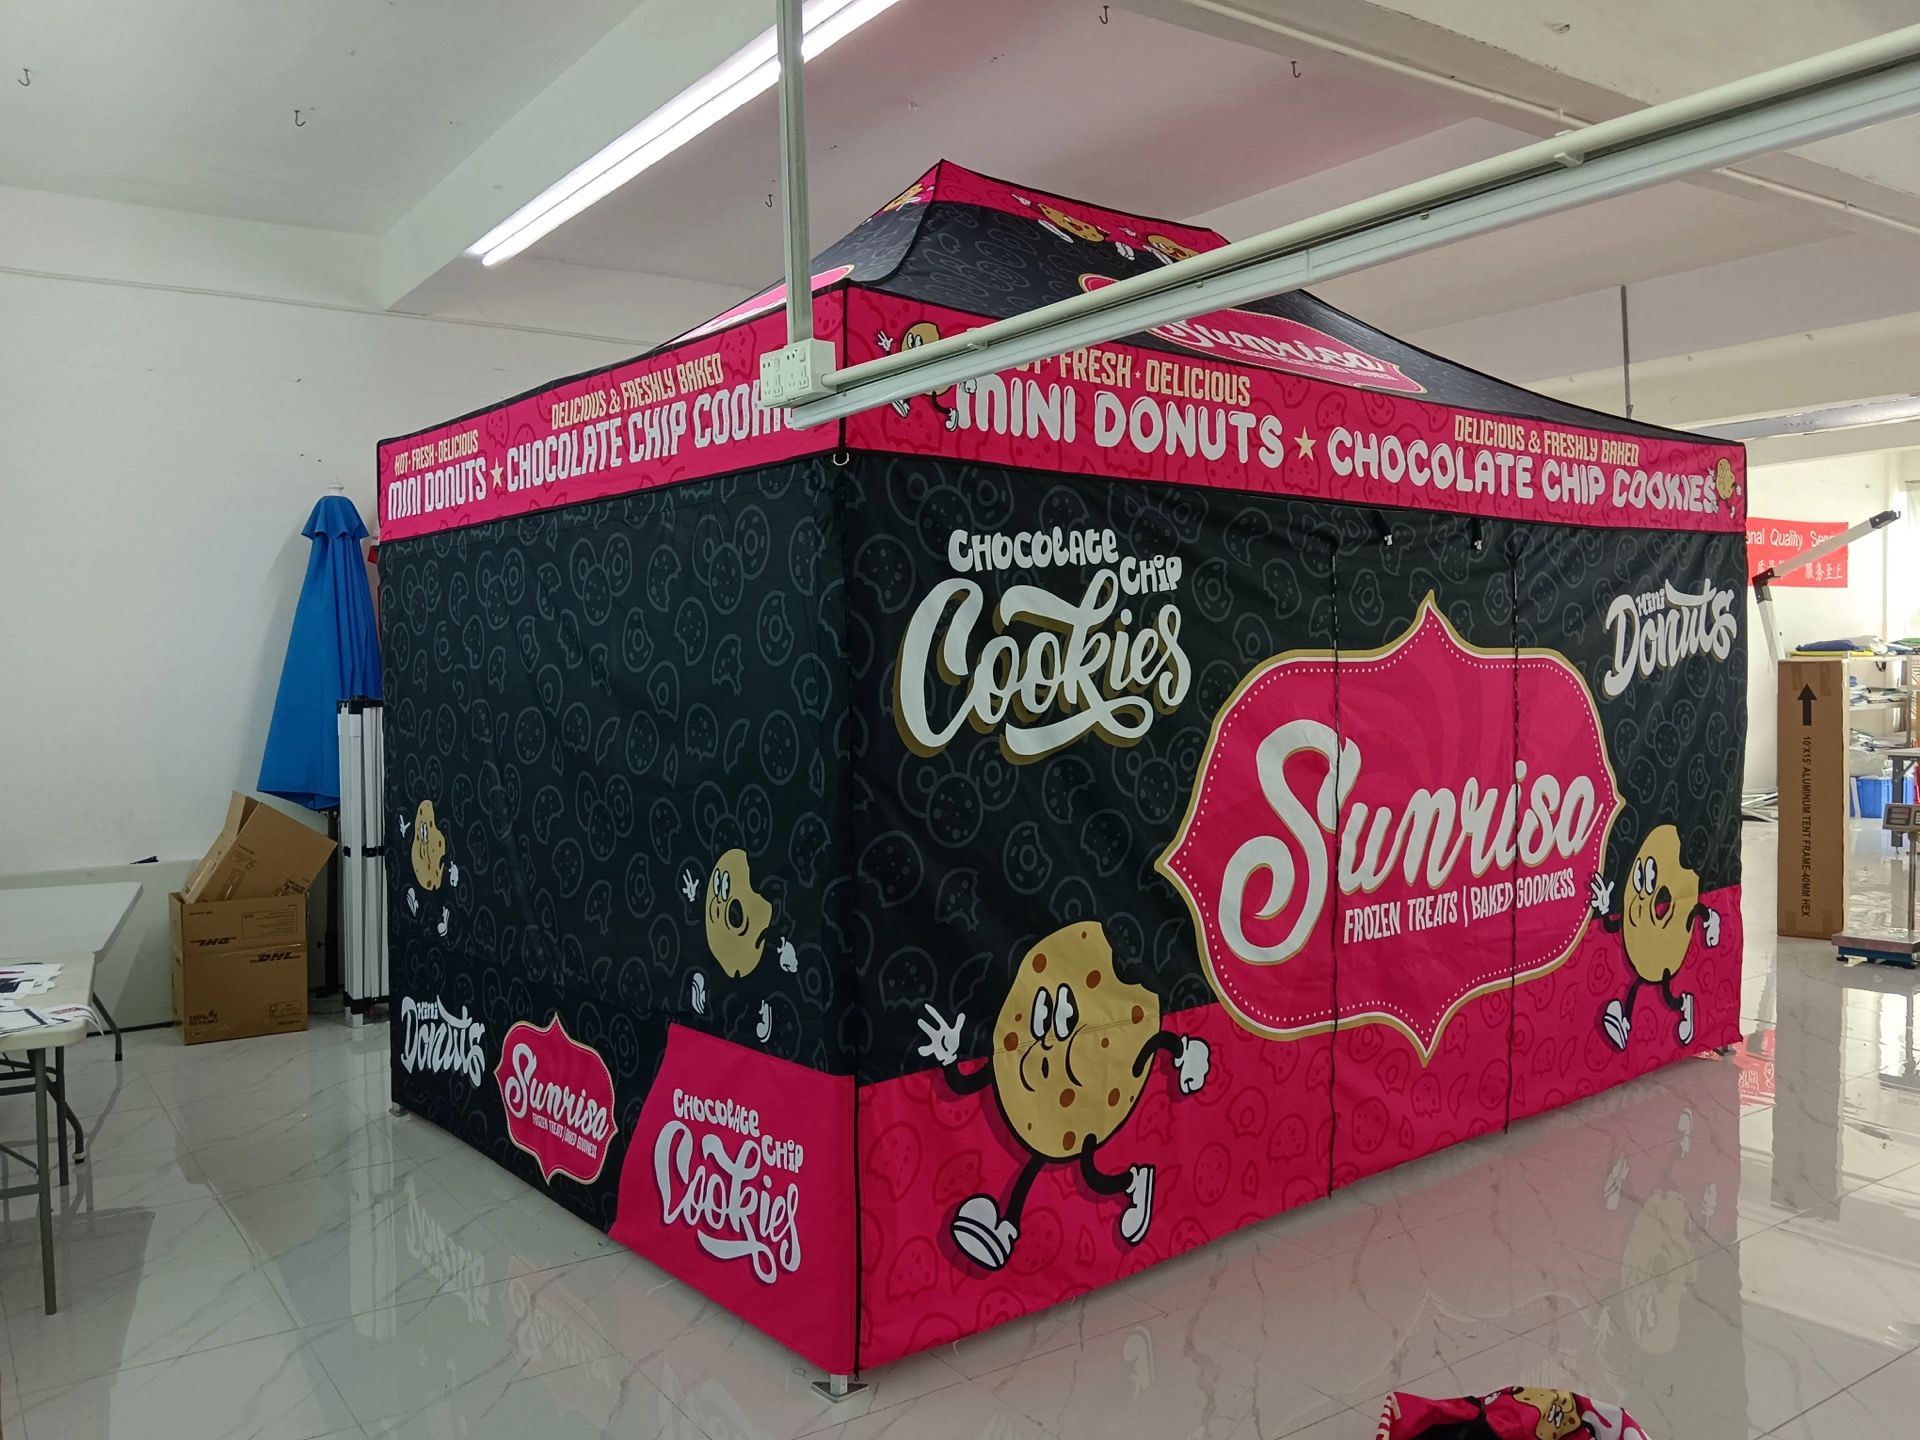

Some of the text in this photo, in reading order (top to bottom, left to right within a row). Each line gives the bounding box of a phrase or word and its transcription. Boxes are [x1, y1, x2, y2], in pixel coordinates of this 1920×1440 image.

[552, 352, 724, 430] DELICIOUS & FRESHLY BAKED
[1059, 347, 1132, 389] FRESH
[1145, 359, 1252, 408] DELICIOUS
[395, 429, 479, 475] HOT FRESH DELICIOUS
[507, 379, 806, 492] CHOCOLATE CHIP COOK
[956, 373, 1285, 469] MINI DONUTS
[1454, 414, 1640, 468] DELICIOUS & FRESHLY BAKED
[388, 457, 487, 520] MINI DONUTS
[1327, 426, 1717, 513] CHOCOLATE CHIP COOKIES
[1770, 528, 1803, 551] Quality
[897, 568, 1192, 760] Cookies
[1603, 577, 1737, 699] Donuts
[1802, 767, 1812, 813] ALUMINUM
[1802, 815, 1812, 837] TENT
[1343, 867, 1576, 944] FROZEN TREATS BAKED GOODNESS
[1801, 899, 1812, 917] HEX
[254, 951, 297, 963] DHL
[400, 995, 486, 1087] Donuts
[654, 1120, 802, 1285] Cookies
